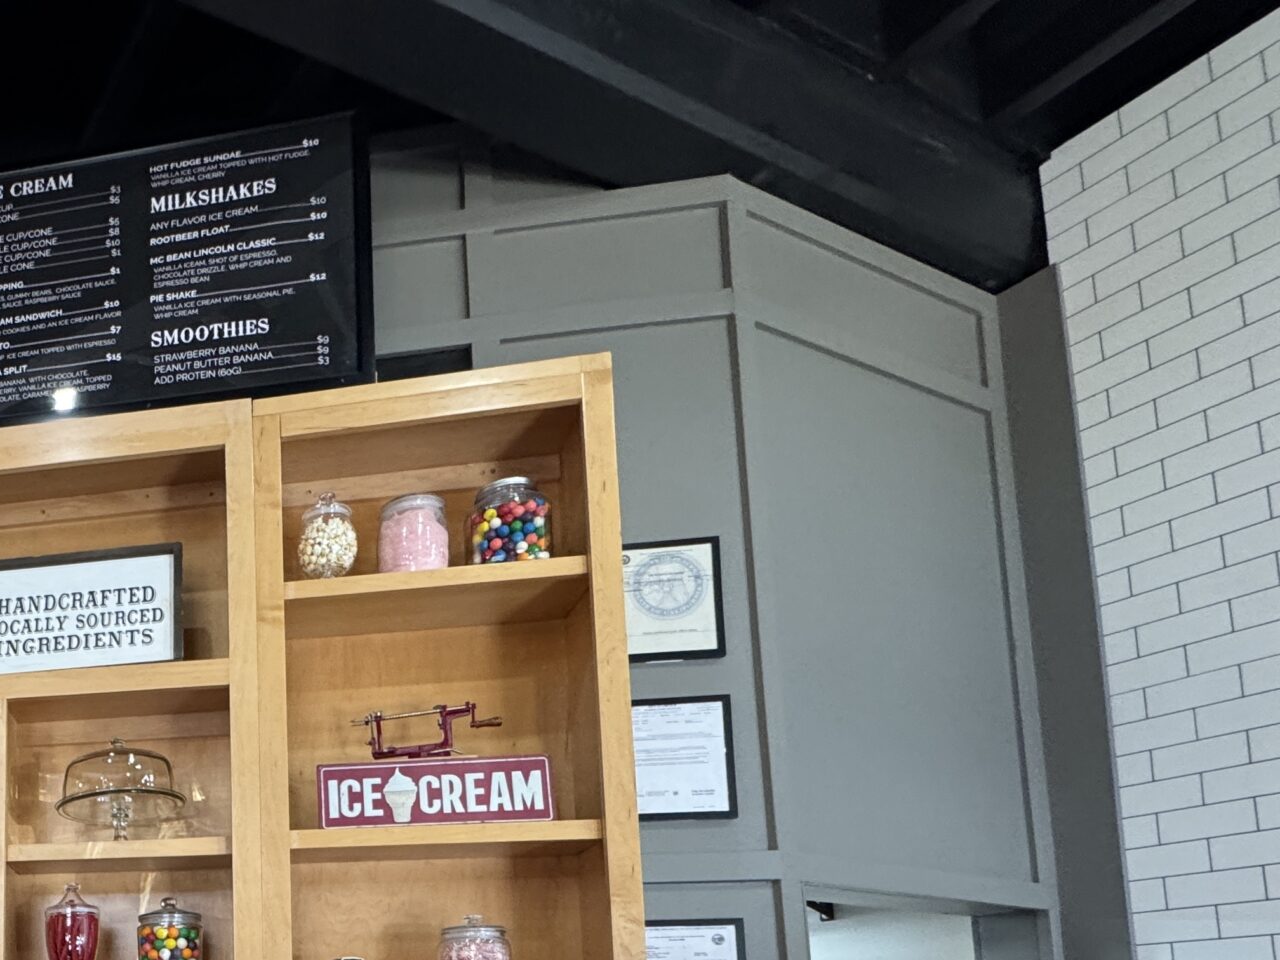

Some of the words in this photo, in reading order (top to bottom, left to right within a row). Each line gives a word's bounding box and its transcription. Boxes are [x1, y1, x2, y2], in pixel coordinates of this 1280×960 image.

[150, 163, 169, 173] HOT
[170, 158, 202, 170] FUDGE
[203, 151, 242, 165] SUNDAE
[302, 138, 319, 148] $10
[10, 173, 74, 198] CREAM
[150, 178, 278, 213] MILKSHAKES
[150, 221, 170, 231] ANY
[170, 214, 207, 227] FLAVOR
[208, 211, 224, 221] ICE
[225, 204, 260, 218] CREAM
[310, 196, 327, 206] $10
[6, 227, 54, 243] CUP/CONE
[150, 231, 200, 247] ROOTBEER
[200, 224, 231, 237] FLOAT
[310, 212, 327, 221] $10
[4, 249, 52, 264] CUP/CONE
[10, 238, 59, 253] CUP/CONE
[150, 255, 165, 265] MC
[166, 250, 192, 262] BEAN
[193, 243, 235, 258] LINCOLN
[236, 237, 277, 251] CLASSIC
[308, 232, 326, 241] $12
[10, 260, 36, 272] CONE
[150, 294, 165, 304] PIE
[166, 289, 198, 301] SHAKE
[310, 272, 327, 282] $12
[15, 309, 64, 324] SANDWICH
[104, 300, 120, 309] $10
[150, 317, 270, 348] SMOOTHIES
[153, 348, 217, 364] STRAWBERRY
[218, 342, 260, 355] BANANA
[153, 361, 193, 375] PEANUT
[193, 356, 232, 368] BUTTER
[232, 350, 275, 364] BANANA
[3, 364, 29, 376] SPLIT
[153, 375, 175, 385] ADD
[176, 369, 217, 382] PROTEIN
[74, 607, 165, 632] SOURCED
[327, 777, 384, 819] ICE
[418, 769, 544, 814] CREAM
